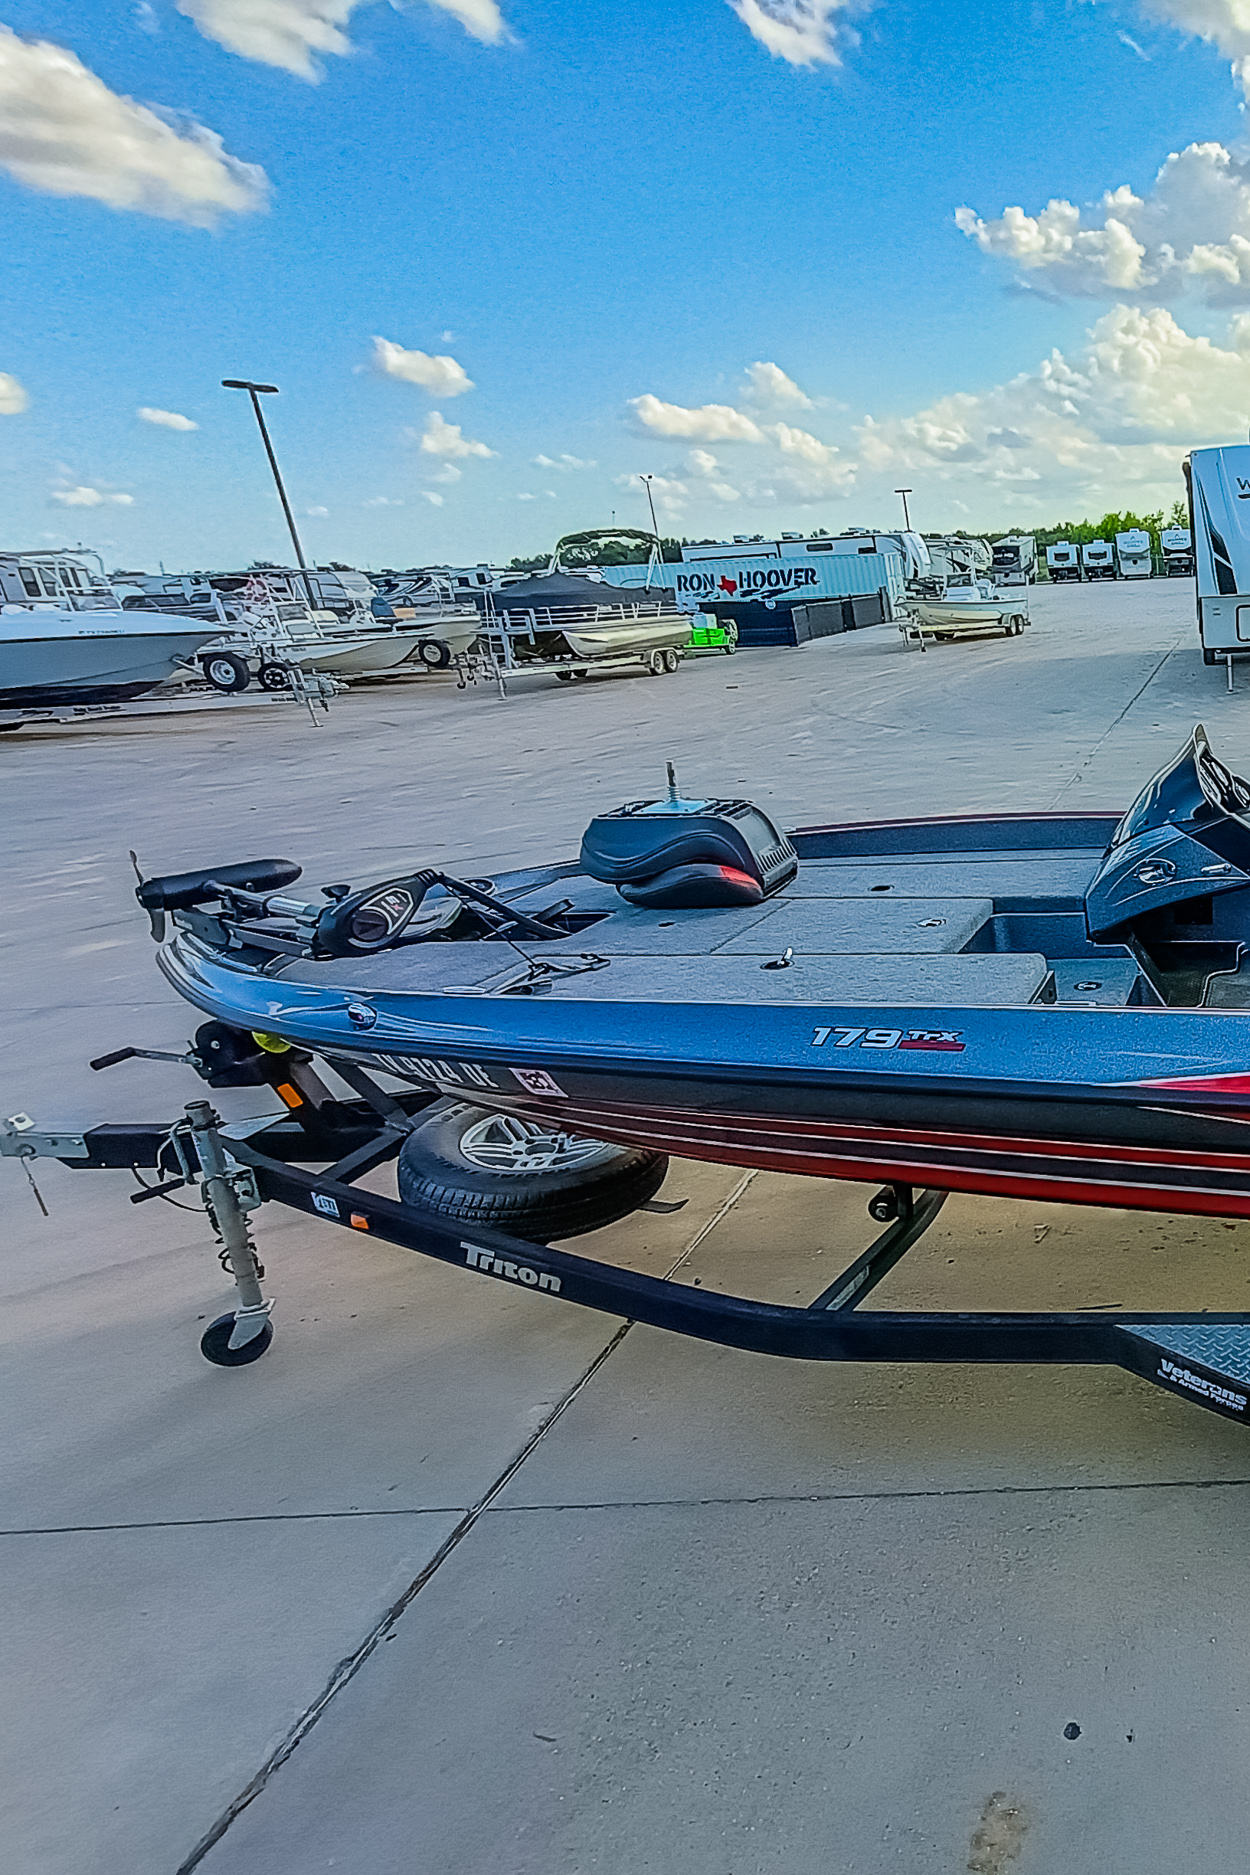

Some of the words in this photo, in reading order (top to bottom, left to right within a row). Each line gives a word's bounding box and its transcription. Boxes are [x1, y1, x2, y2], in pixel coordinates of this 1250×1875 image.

[676, 573, 716, 592] RON
[738, 567, 818, 589] HOOVER
[811, 1026, 903, 1049] 179
[460, 1241, 562, 1293] Triton
[1160, 1358, 1248, 1406] Veterans
